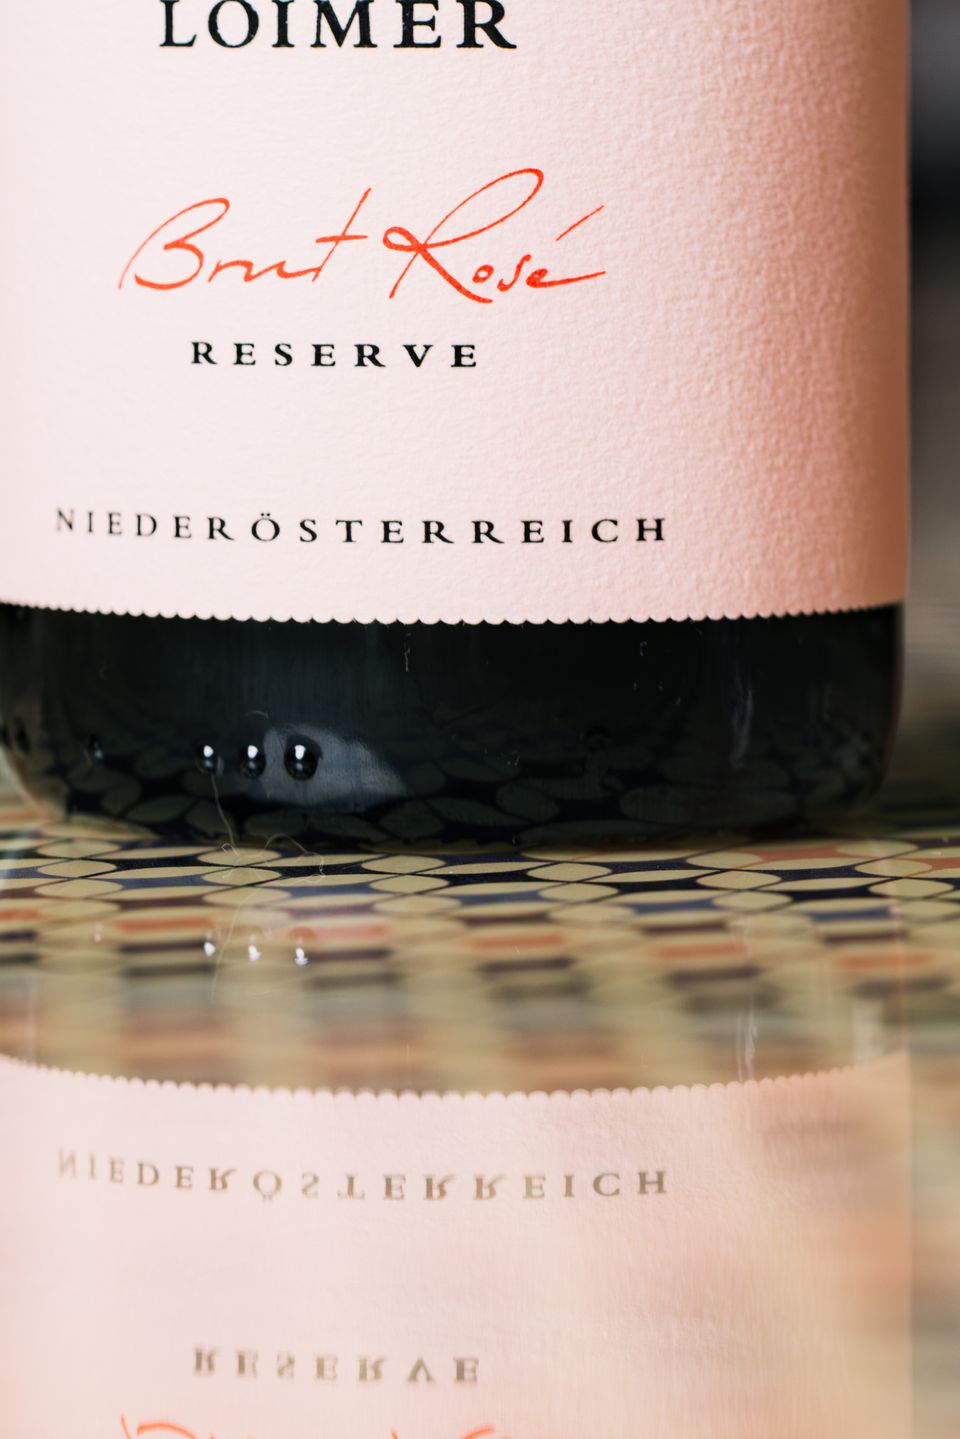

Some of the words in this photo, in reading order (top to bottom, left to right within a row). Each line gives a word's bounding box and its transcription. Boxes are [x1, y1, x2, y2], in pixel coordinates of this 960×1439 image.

[118, 187, 371, 291] Brut
[382, 167, 607, 304] Rosé
[190, 341, 478, 368] RESERVE
[55, 506, 668, 545] NIEDERÖSTERREICH
